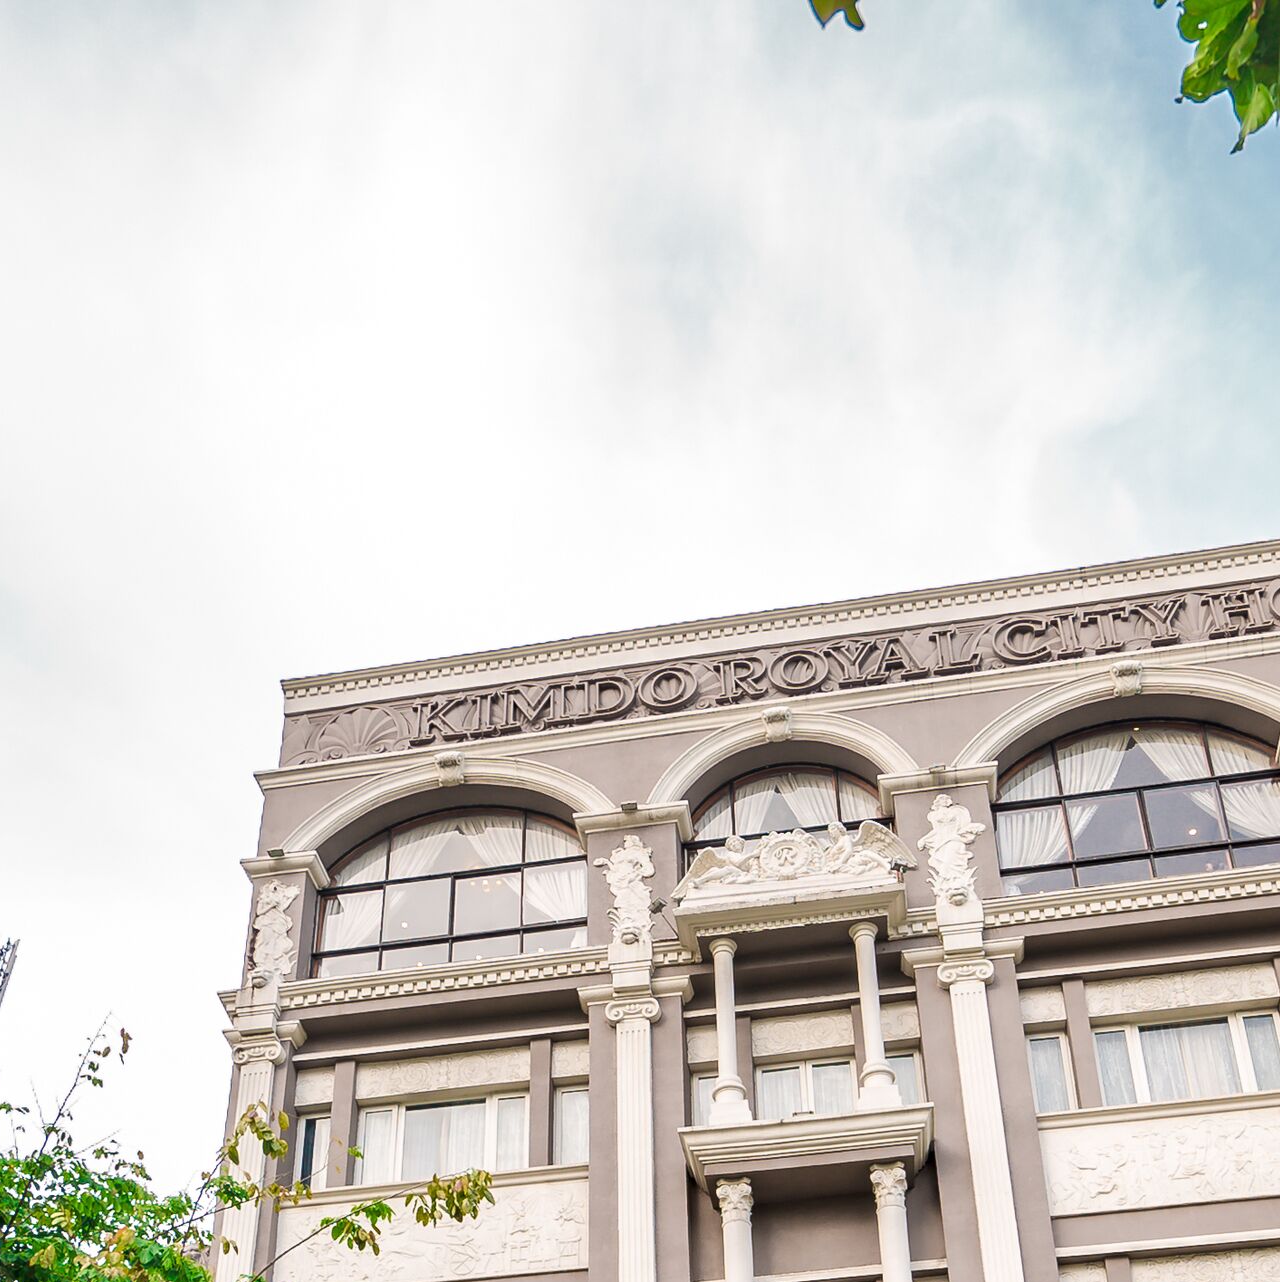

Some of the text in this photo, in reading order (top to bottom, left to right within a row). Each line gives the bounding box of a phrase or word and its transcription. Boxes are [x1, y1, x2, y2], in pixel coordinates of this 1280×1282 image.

[408, 662, 699, 748] KIMDO
[714, 628, 984, 706] ROYAL
[991, 597, 1185, 664] CITY
